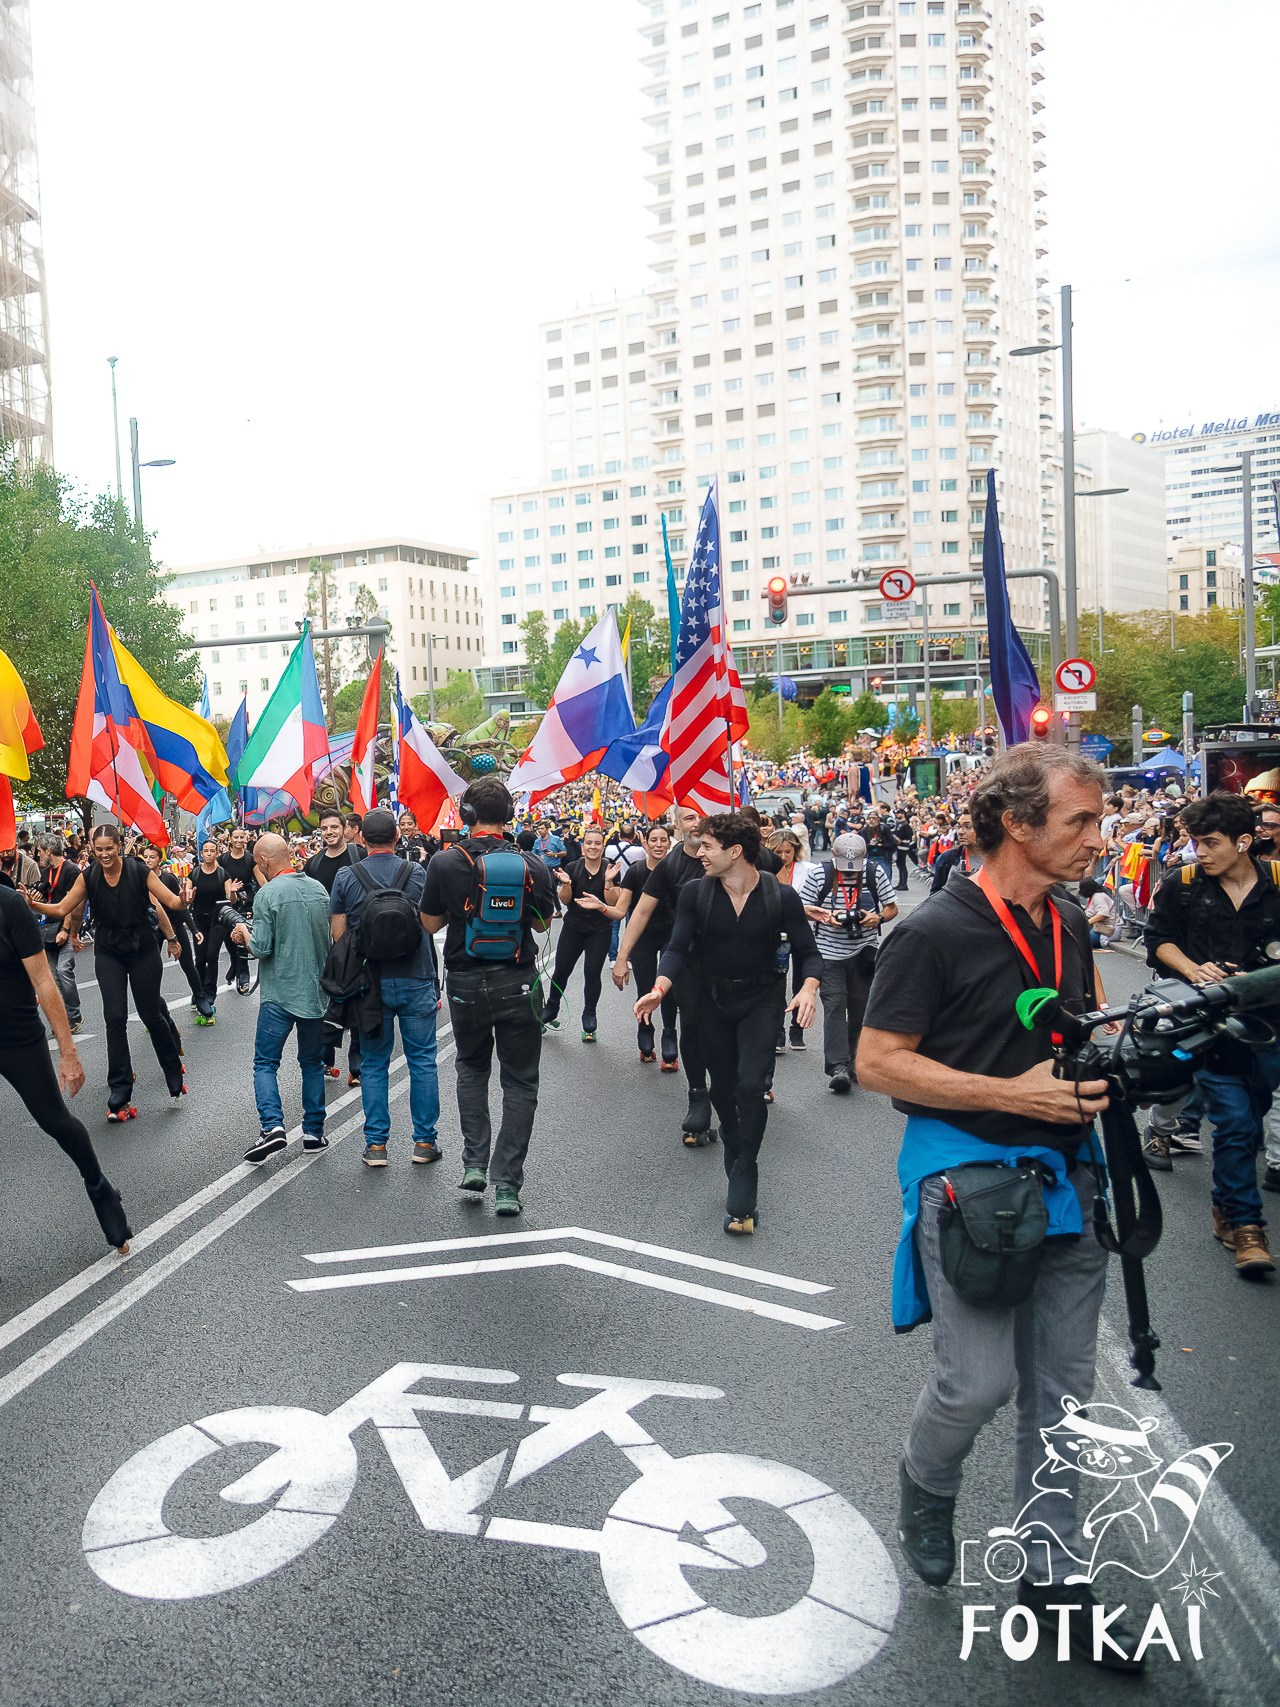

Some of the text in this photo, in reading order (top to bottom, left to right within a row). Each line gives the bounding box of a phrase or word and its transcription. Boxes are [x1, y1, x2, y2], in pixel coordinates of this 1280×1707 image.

[1150, 424, 1194, 443] Hotel
[1254, 413, 1280, 426] Ma
[490, 898, 514, 908] LiveU
